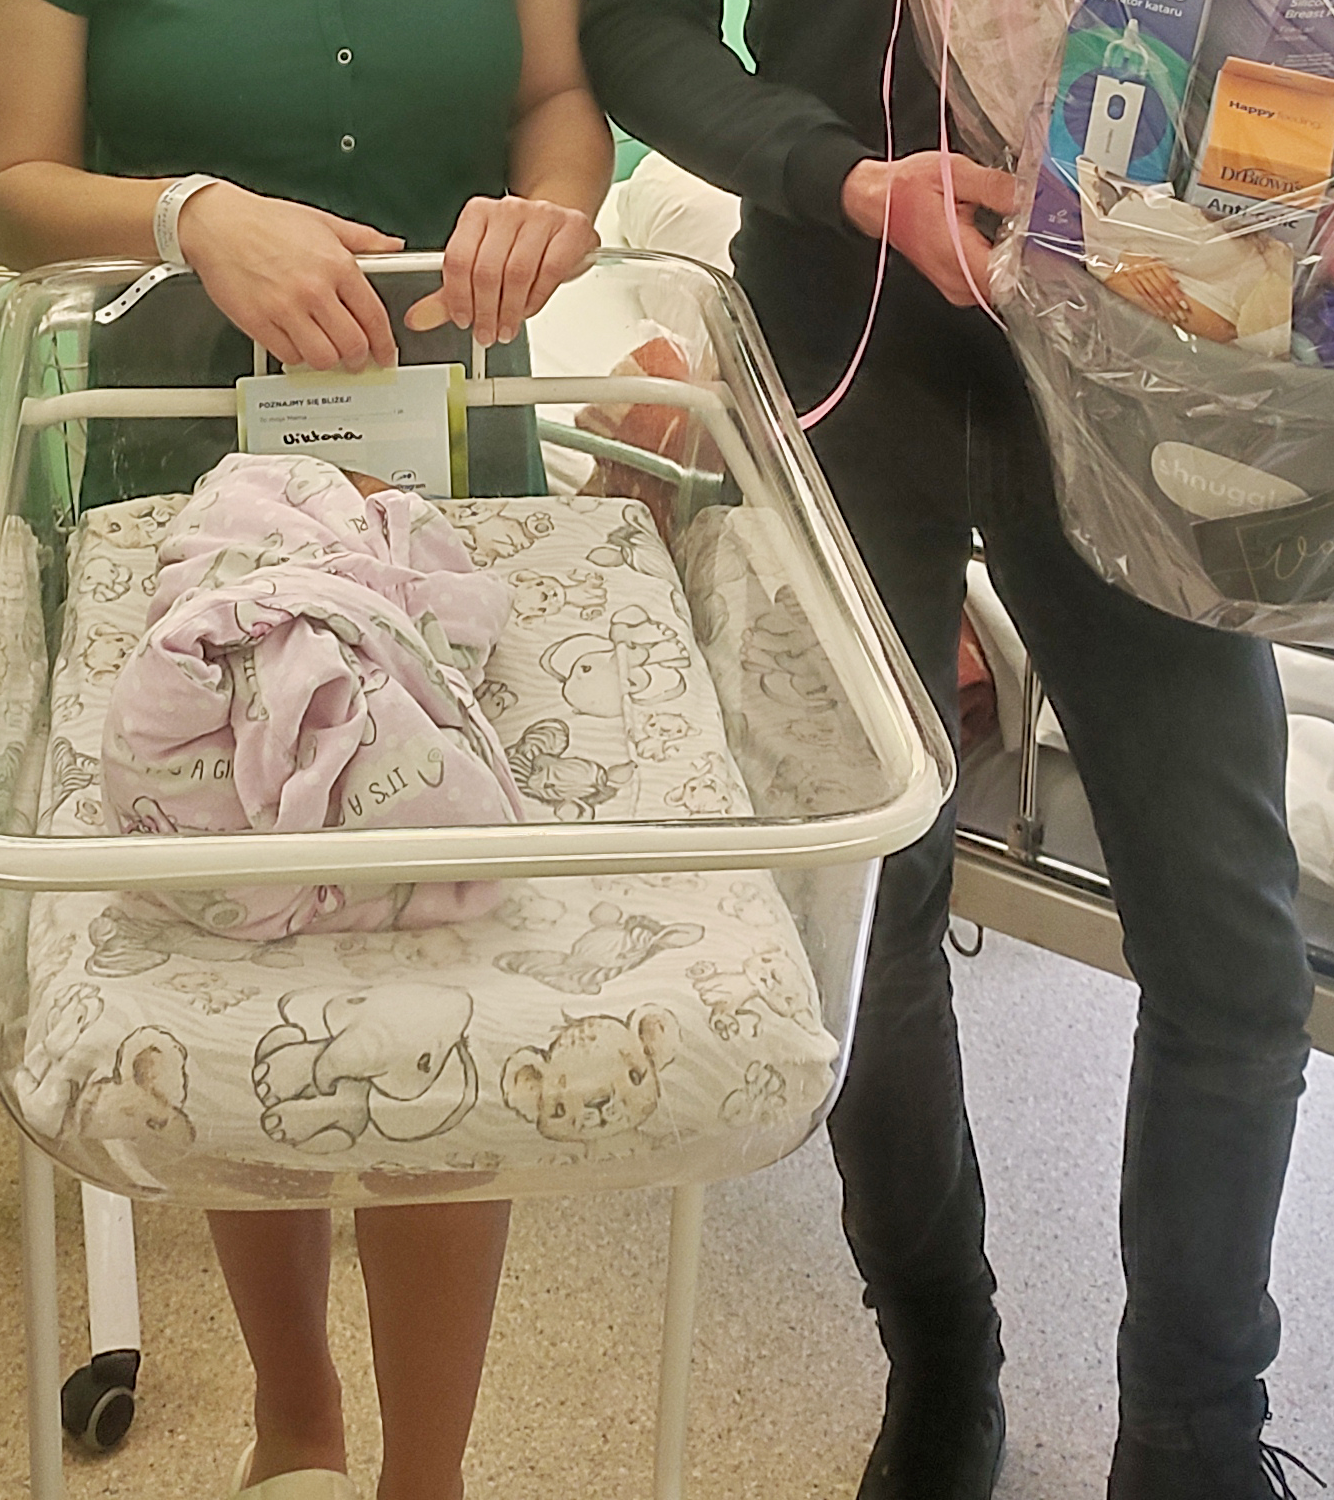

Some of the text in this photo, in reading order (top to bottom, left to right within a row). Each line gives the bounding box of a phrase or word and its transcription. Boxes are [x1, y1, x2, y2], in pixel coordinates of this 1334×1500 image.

[1145, 0, 1183, 17] kataru
[1285, 8, 1324, 19] Breast
[1229, 100, 1275, 119] Happy
[259, 400, 304, 409] POZNAJMY
[1158, 457, 1277, 507] shnuggl
[190, 759, 205, 780] A
[347, 766, 409, 817] IT'S A
